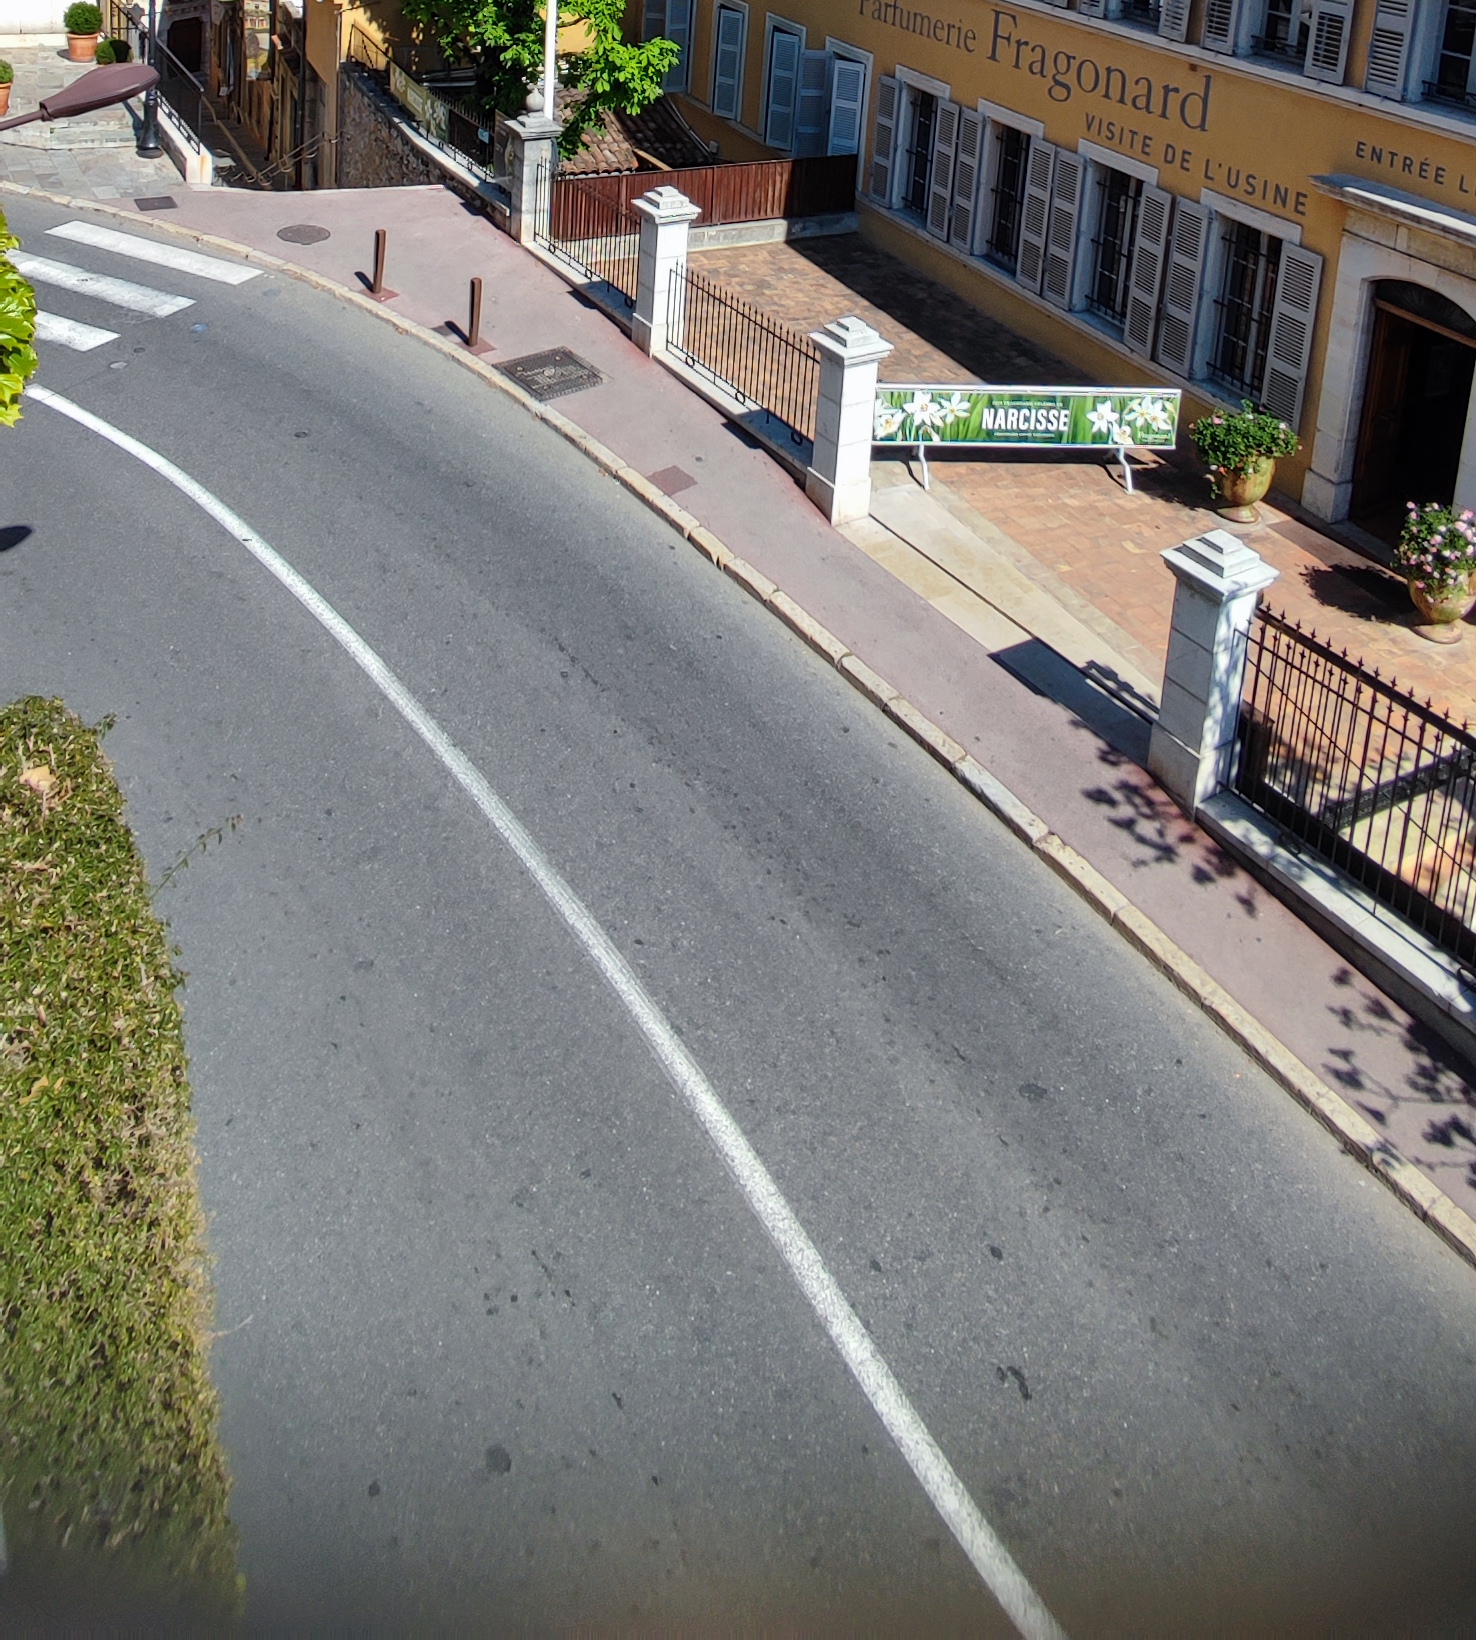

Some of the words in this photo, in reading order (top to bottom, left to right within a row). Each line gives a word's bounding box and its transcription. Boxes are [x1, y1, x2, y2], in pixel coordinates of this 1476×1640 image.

[986, 8, 1212, 132] Fragonard
[1085, 112, 1153, 156] VISITE
[1163, 143, 1192, 172] DE
[1203, 158, 1308, 216] L'USINE
[1356, 141, 1447, 185] ENTRÉE
[1459, 174, 1476, 197] L
[981, 407, 1070, 431] NARCISSE
